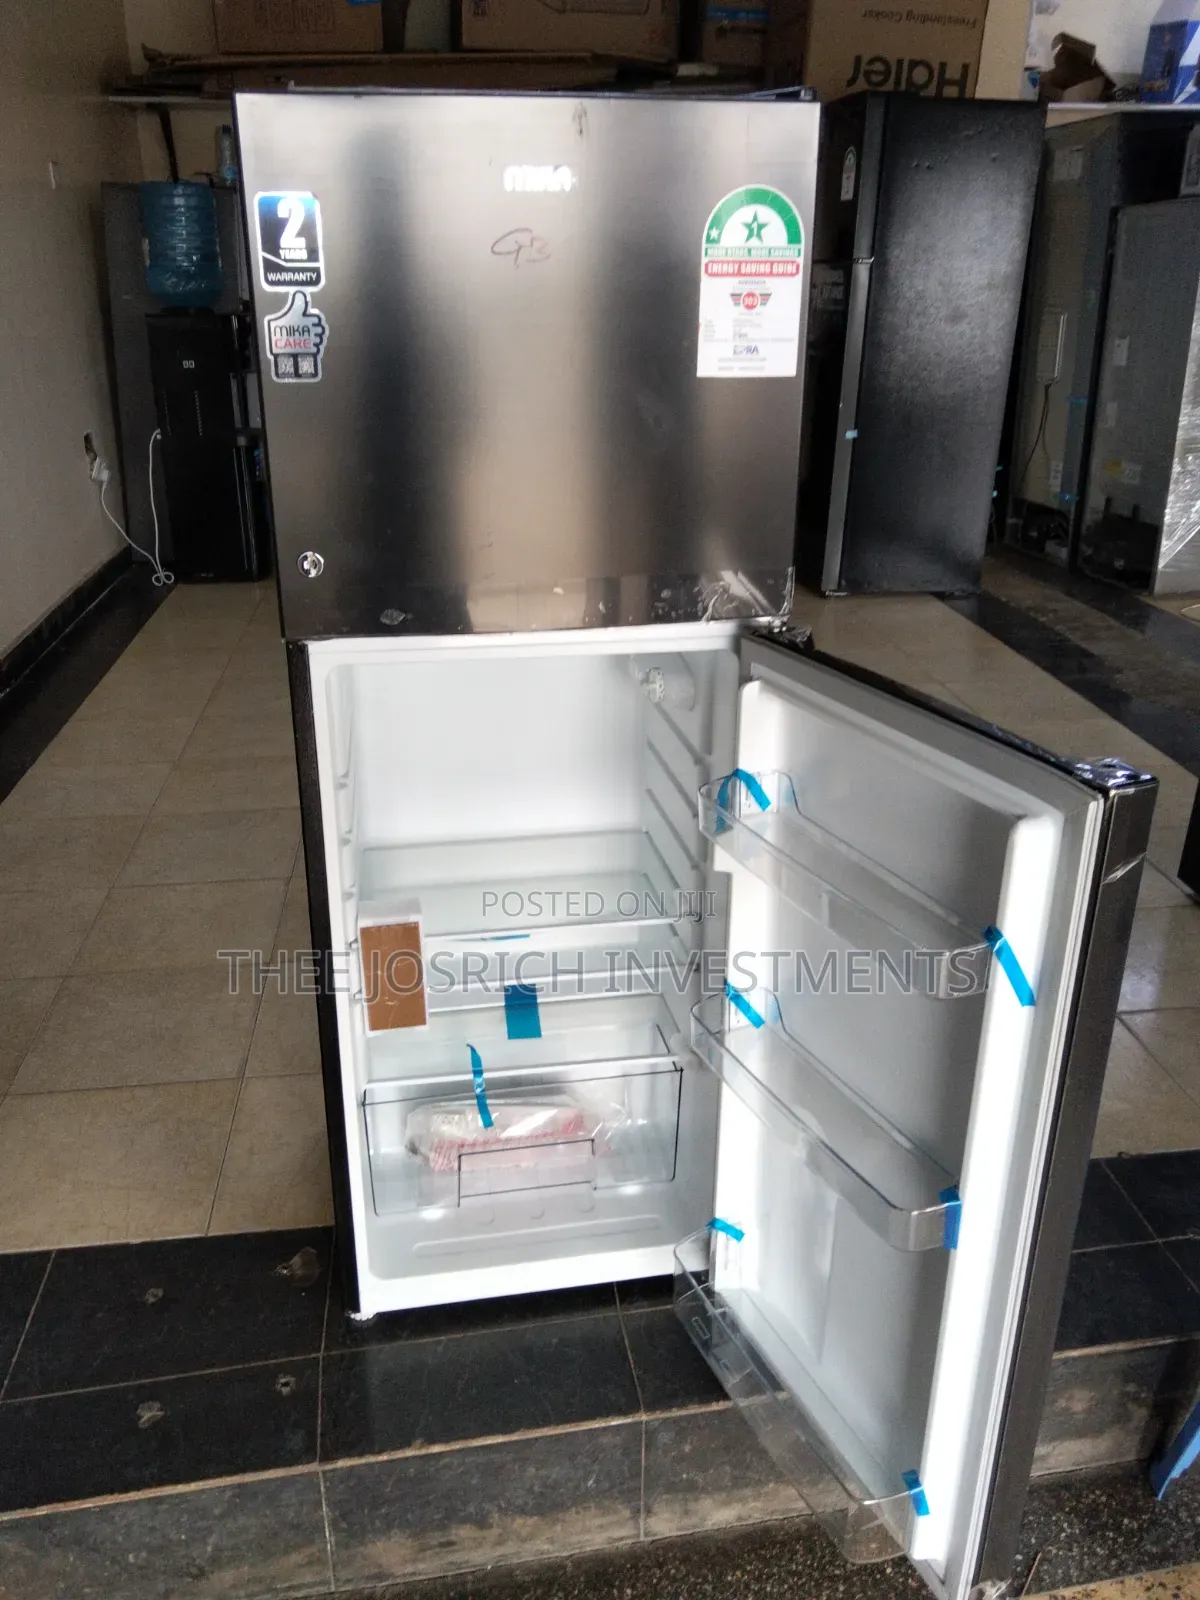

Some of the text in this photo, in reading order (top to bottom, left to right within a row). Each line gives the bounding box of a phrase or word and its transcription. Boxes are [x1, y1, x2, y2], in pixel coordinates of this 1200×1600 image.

[846, 54, 971, 98] Haier
[277, 198, 305, 248] 2
[707, 262, 797, 274] ENERGY SAVING GUIDE
[267, 272, 317, 282] WARRANTY
[273, 325, 311, 337] MIKA
[274, 338, 311, 349] CARE
